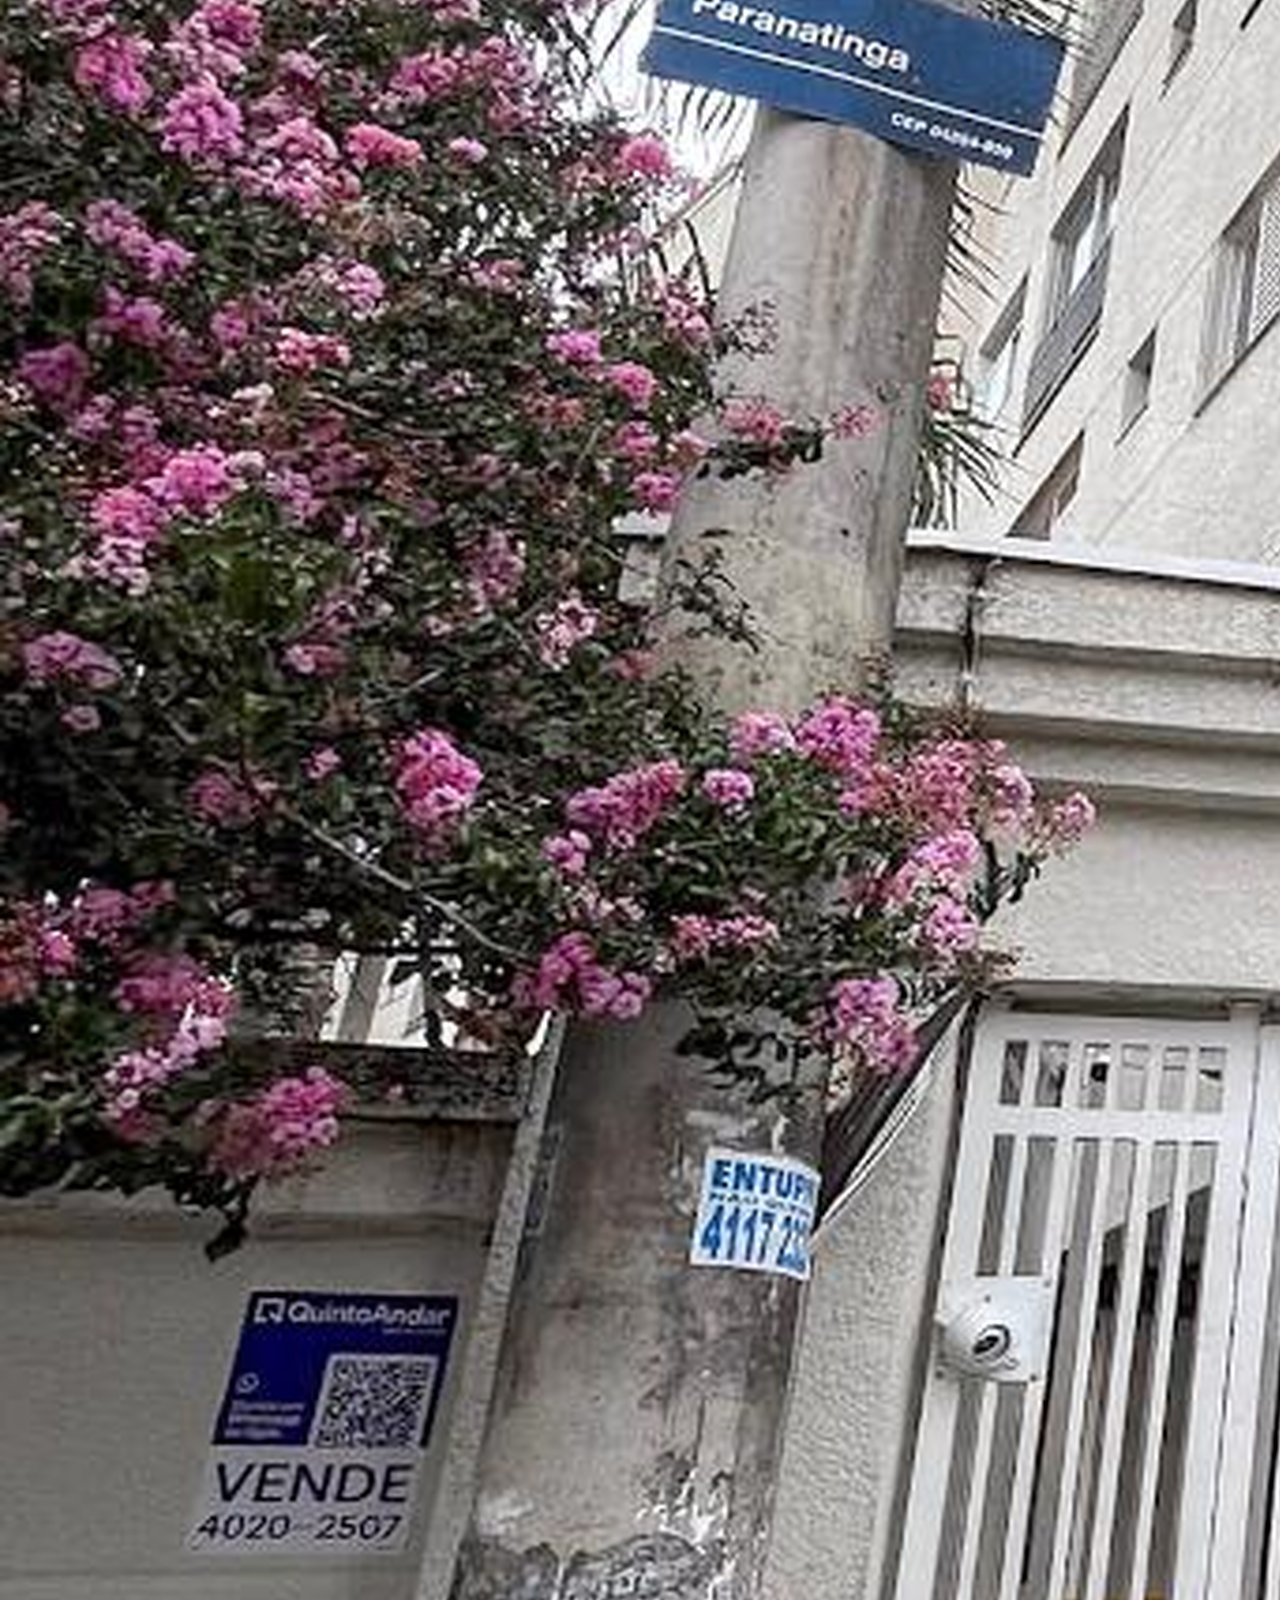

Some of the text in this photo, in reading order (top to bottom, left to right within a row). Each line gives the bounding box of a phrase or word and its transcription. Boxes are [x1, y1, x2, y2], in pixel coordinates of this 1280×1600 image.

[701, 1204, 777, 1265] 4117
[288, 1300, 451, 1326] QuintoAndar
[217, 1462, 416, 1503] VENDE
